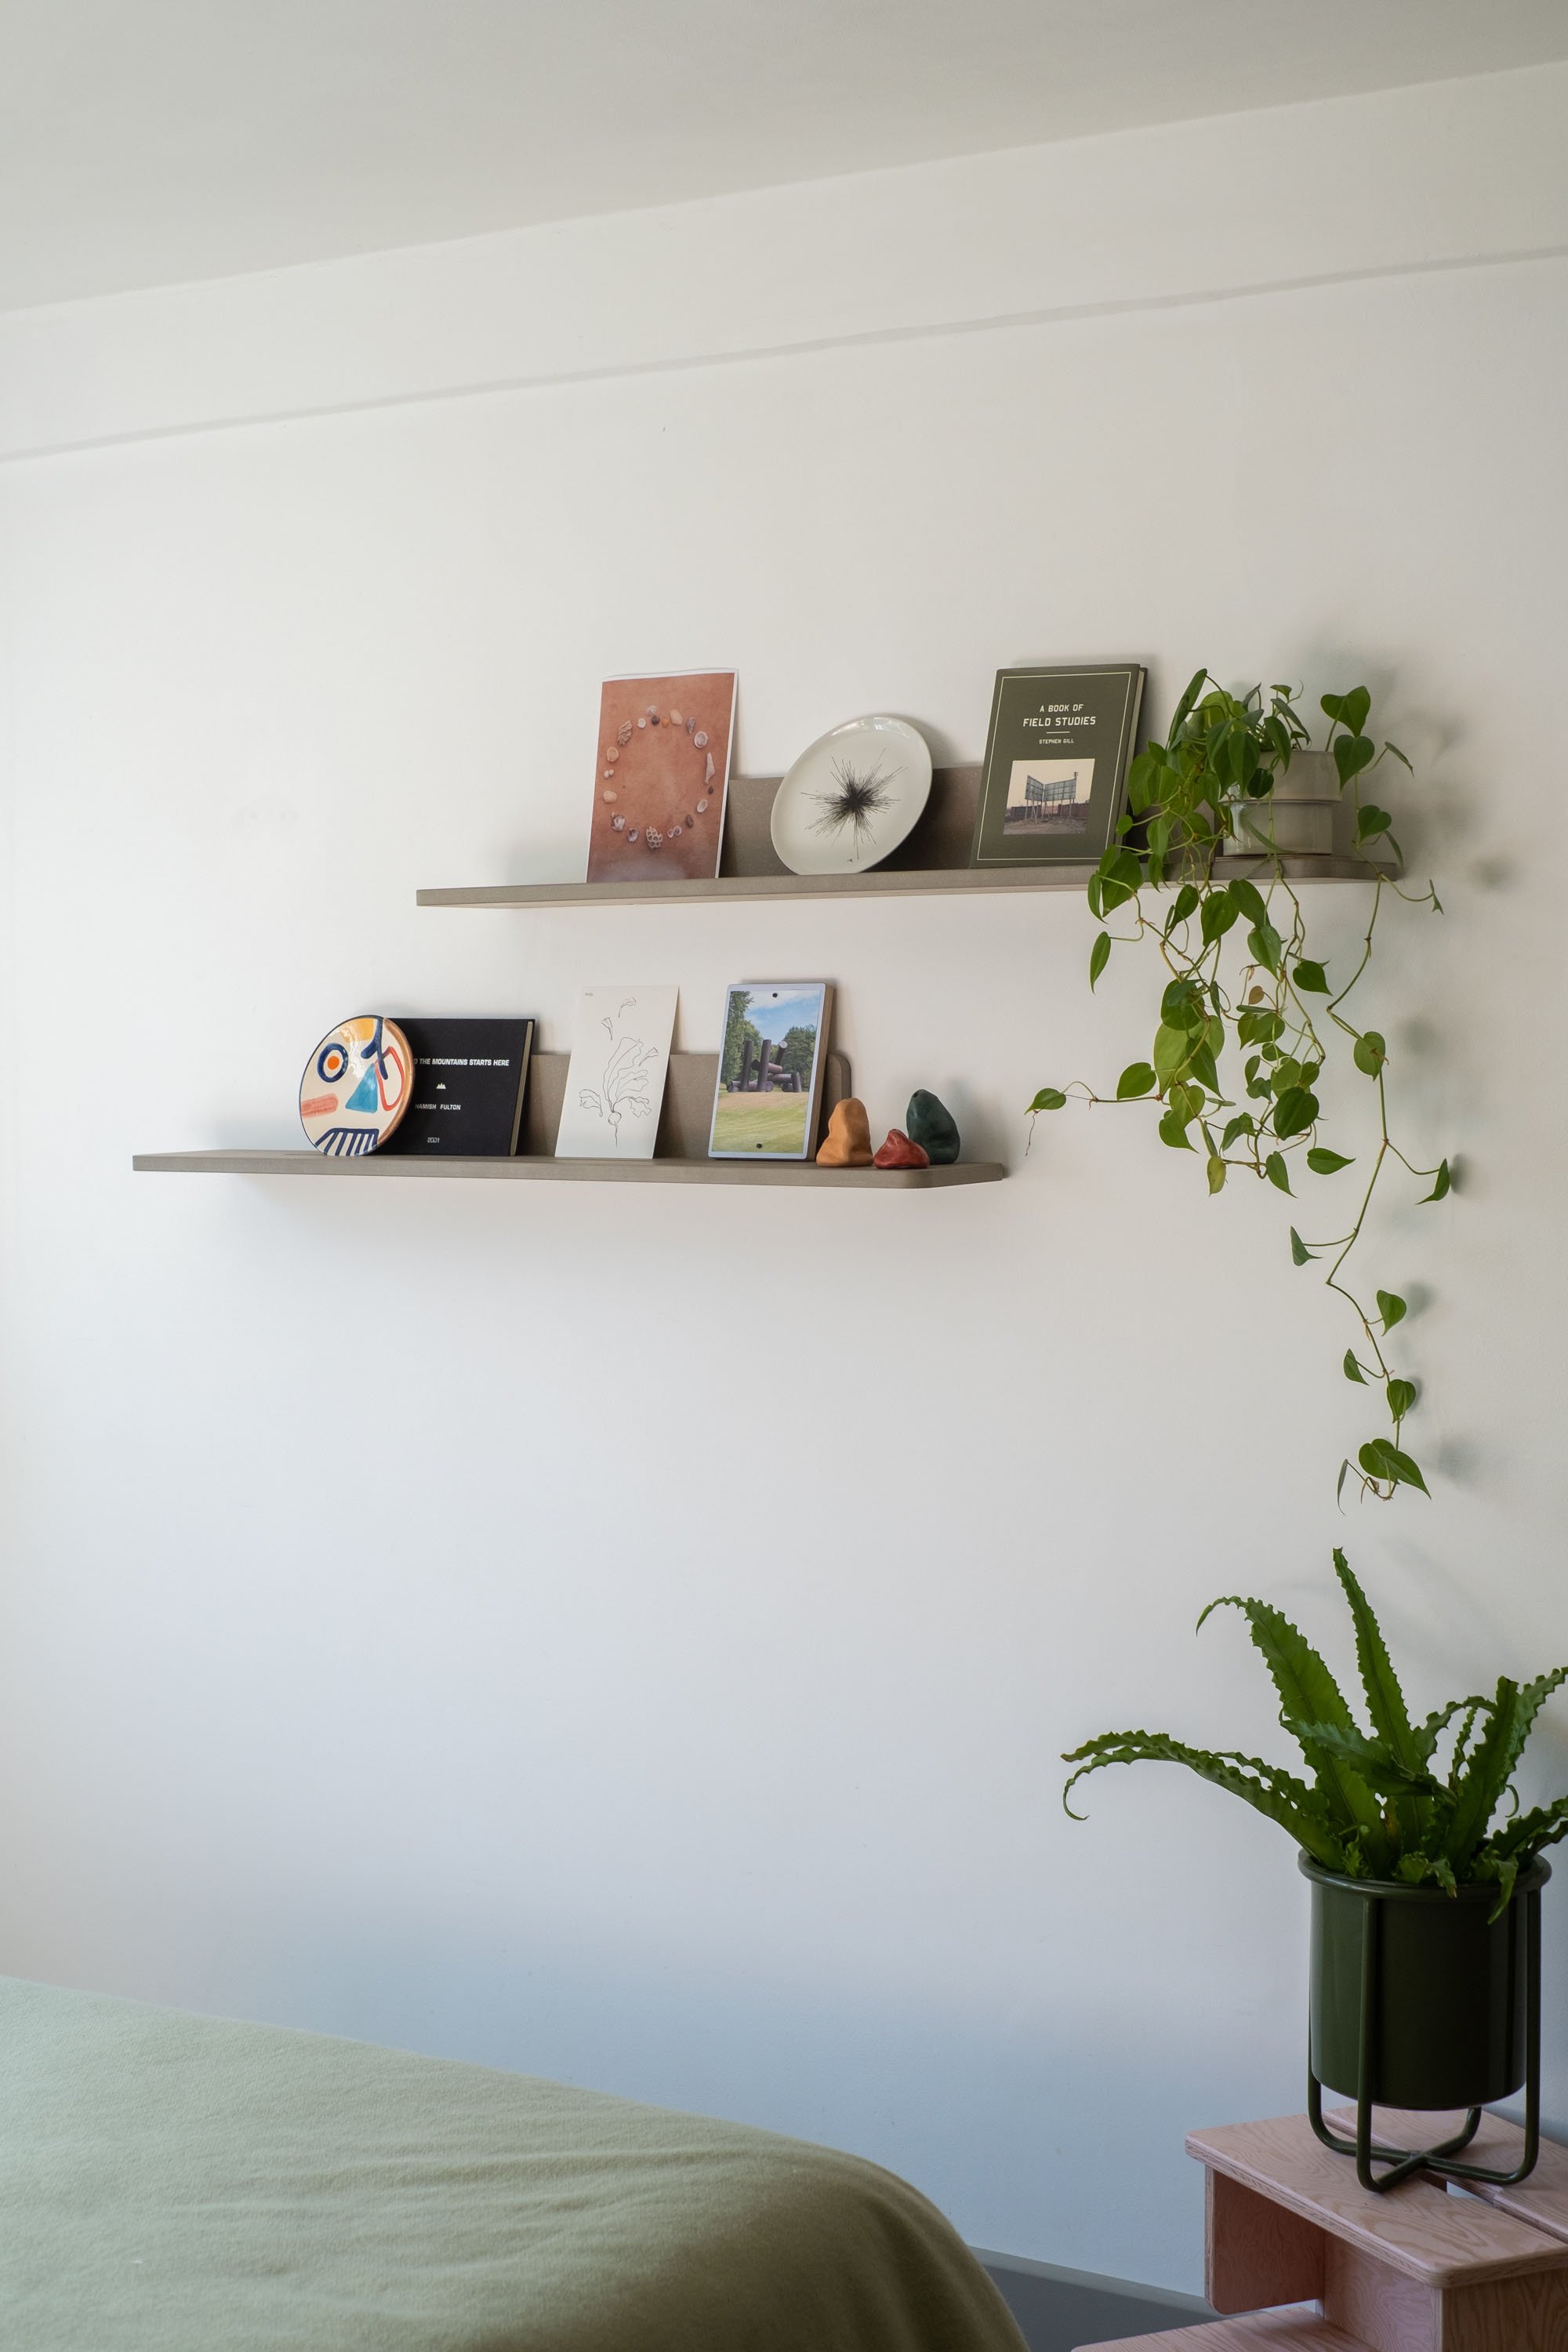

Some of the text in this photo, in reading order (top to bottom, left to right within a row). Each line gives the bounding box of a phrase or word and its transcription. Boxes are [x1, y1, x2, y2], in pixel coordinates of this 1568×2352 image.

[1048, 704, 1069, 713] BOOK
[1023, 717, 1096, 727] FIELD STUDIES
